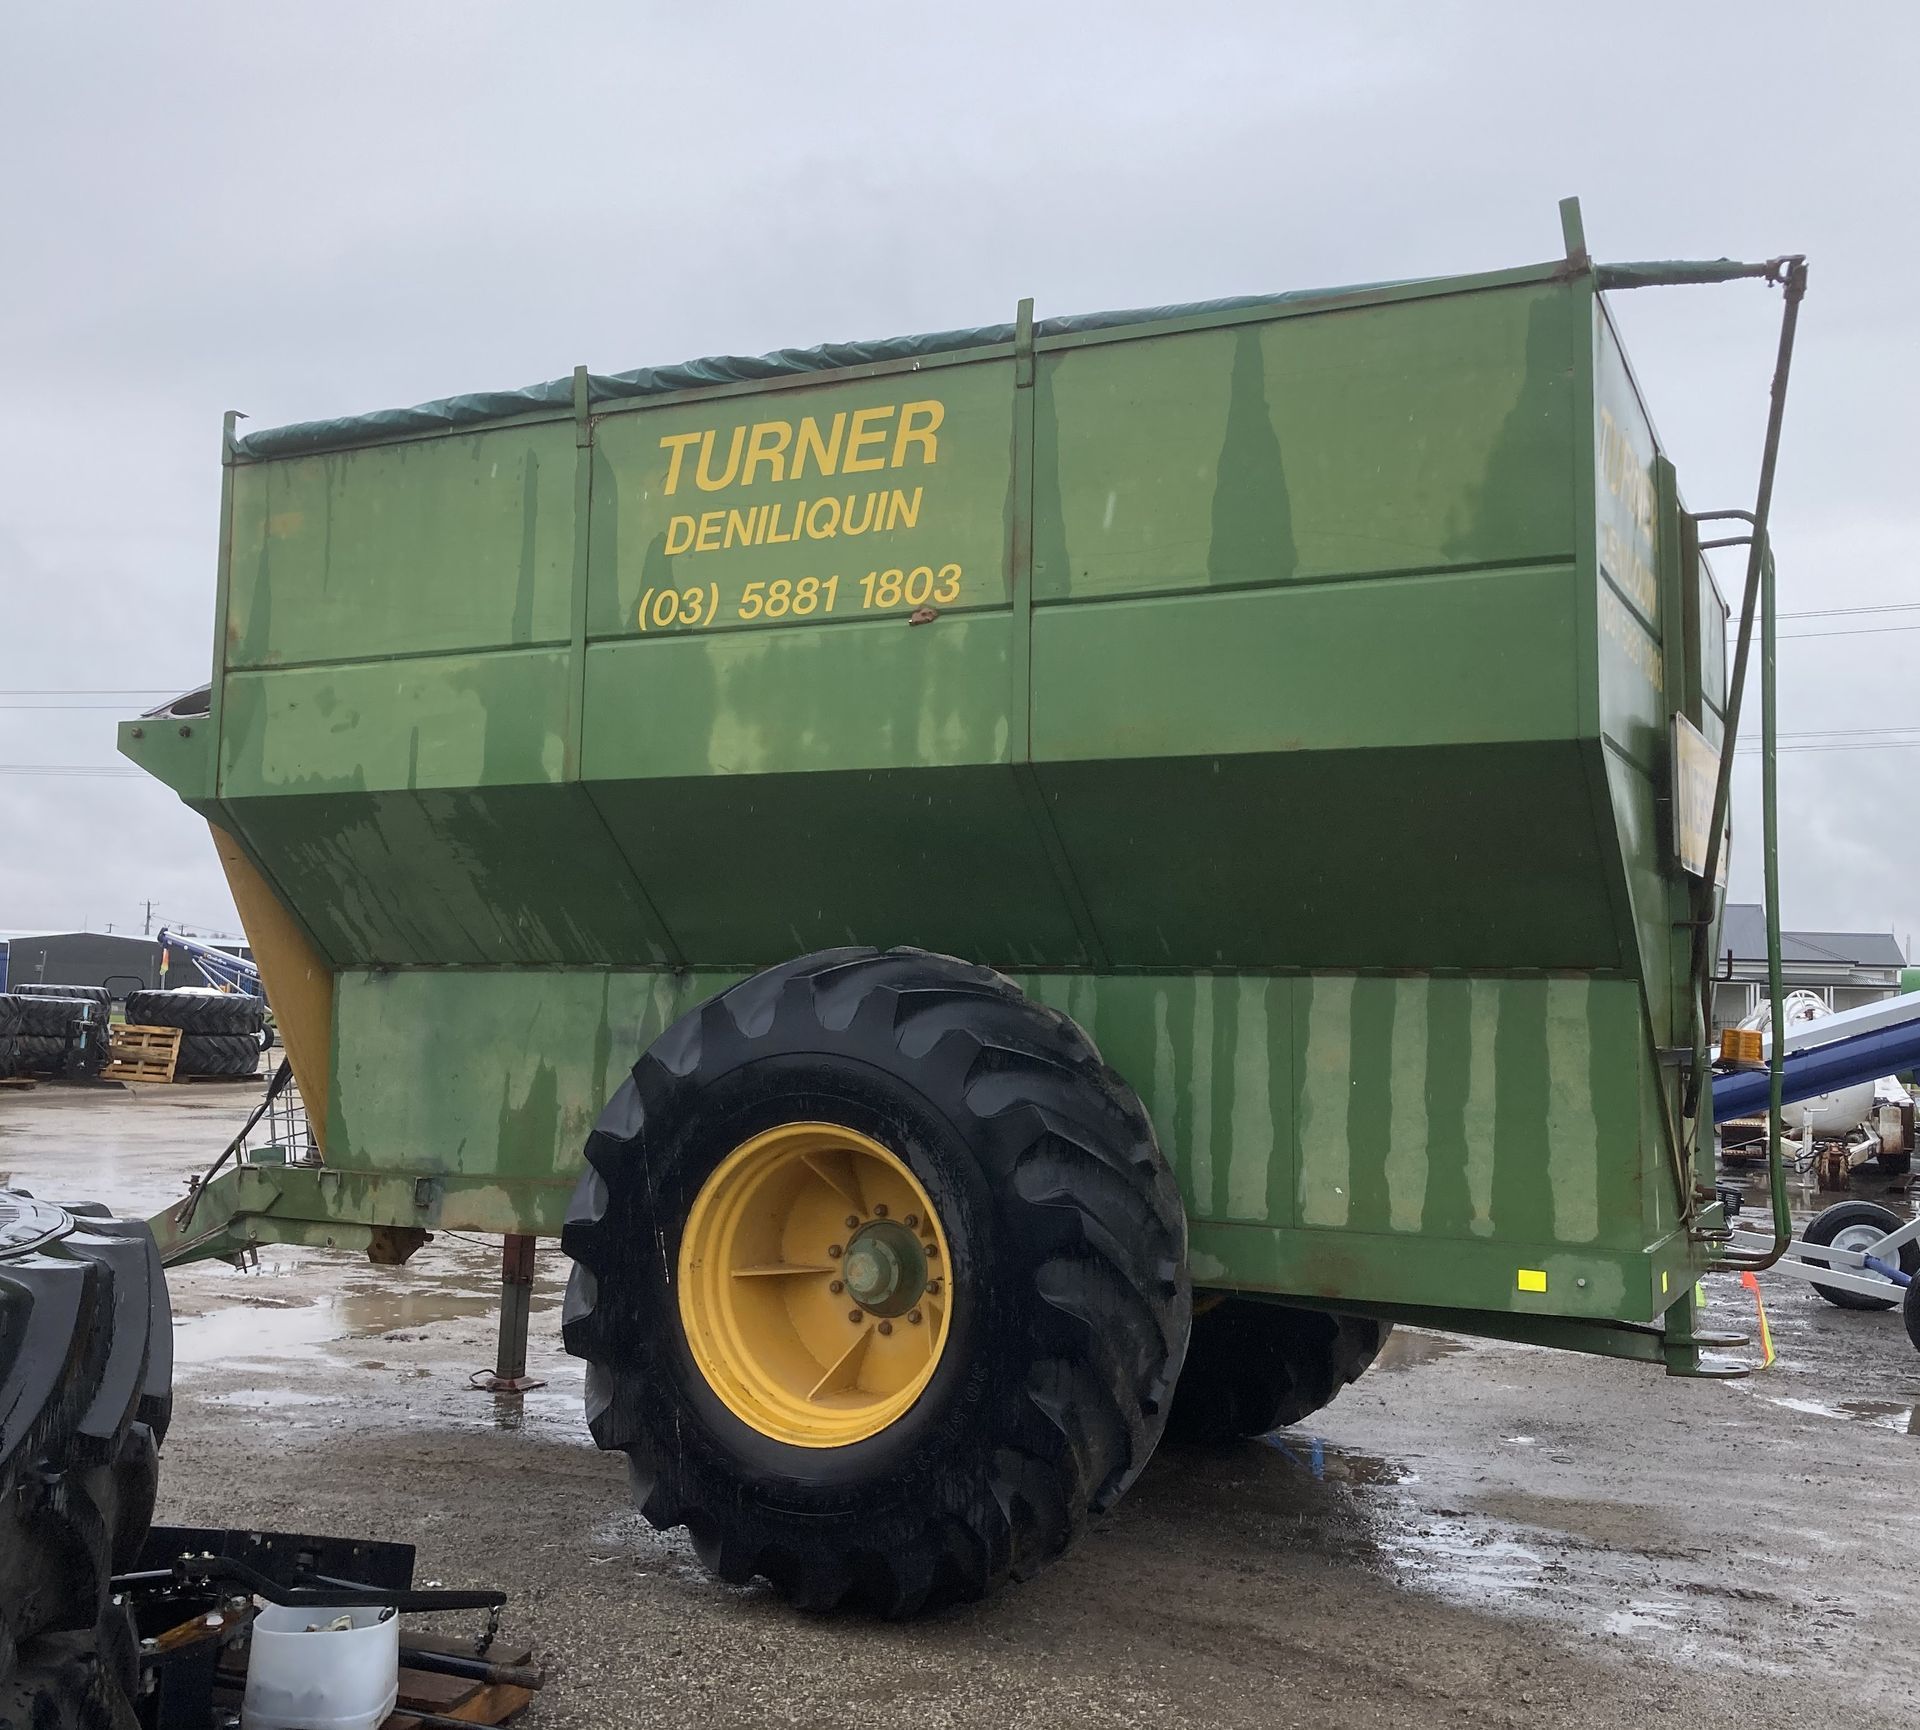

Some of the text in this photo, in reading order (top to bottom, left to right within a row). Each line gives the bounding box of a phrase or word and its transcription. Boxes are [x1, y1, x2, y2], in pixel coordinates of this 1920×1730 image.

[659, 400, 945, 495] TURNER
[664, 487, 923, 555] DENILIQUIN
[638, 564, 962, 631] (03) 5881 1803
